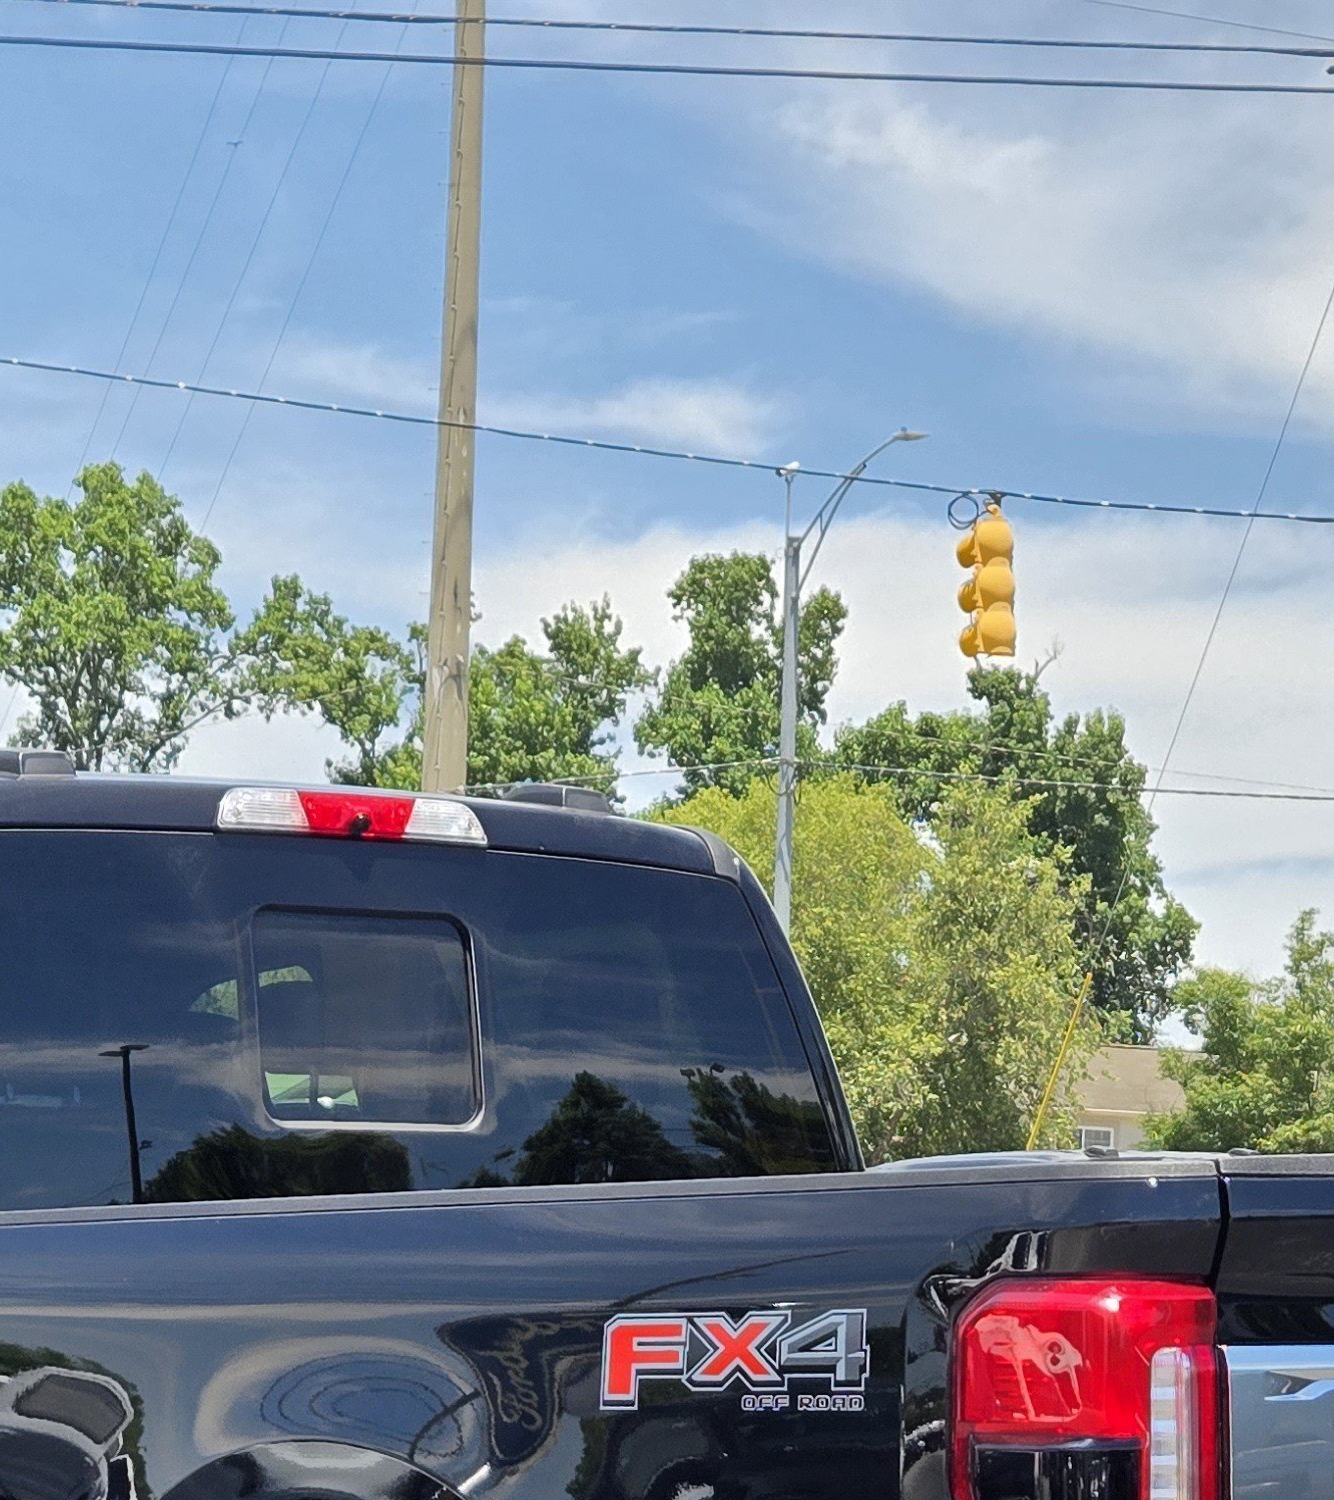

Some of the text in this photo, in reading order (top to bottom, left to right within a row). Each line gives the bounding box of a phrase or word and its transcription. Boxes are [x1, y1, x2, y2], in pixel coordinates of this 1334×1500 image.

[599, 1308, 871, 1411] FX4
[740, 1394, 866, 1412] OFF ROAD
